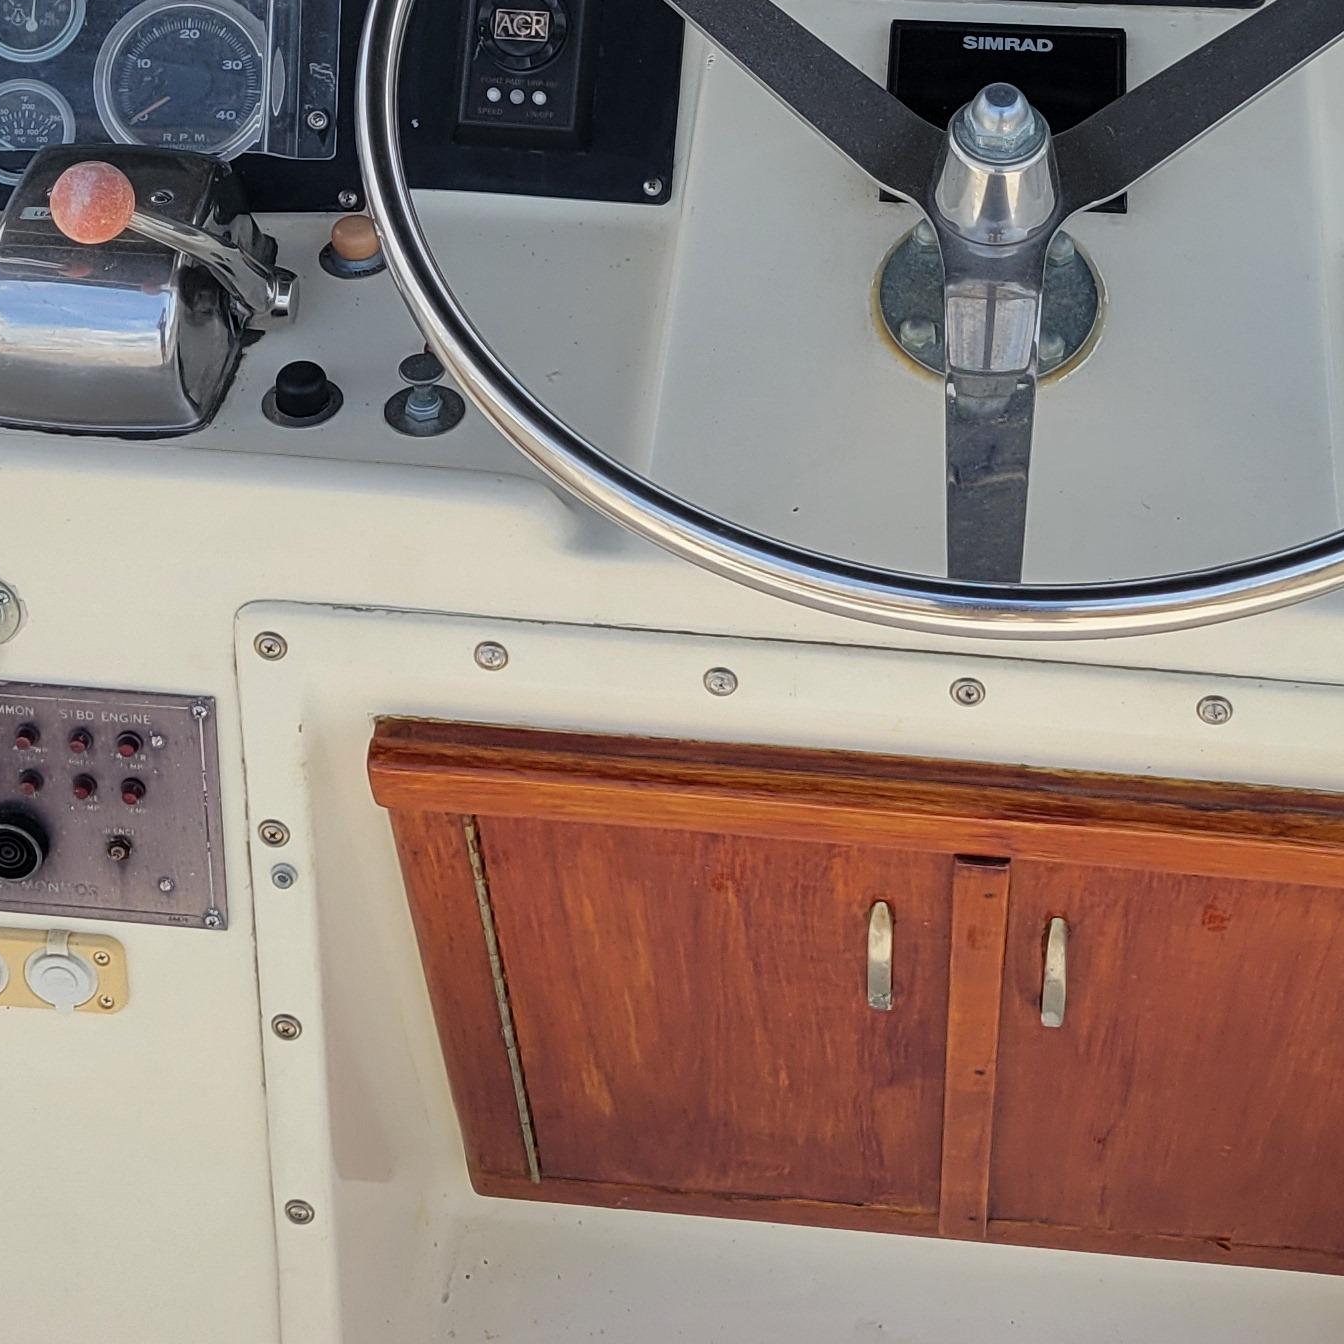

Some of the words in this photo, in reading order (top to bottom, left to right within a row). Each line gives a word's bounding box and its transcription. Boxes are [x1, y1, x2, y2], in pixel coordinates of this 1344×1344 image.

[496, 11, 546, 38] ACR
[179, 29, 200, 39] 20
[962, 35, 1054, 52] SIMRAD
[136, 58, 152, 69] 10
[222, 59, 243, 71] 30
[215, 110, 237, 121] 40
[101, 713, 153, 725] ENGINE
